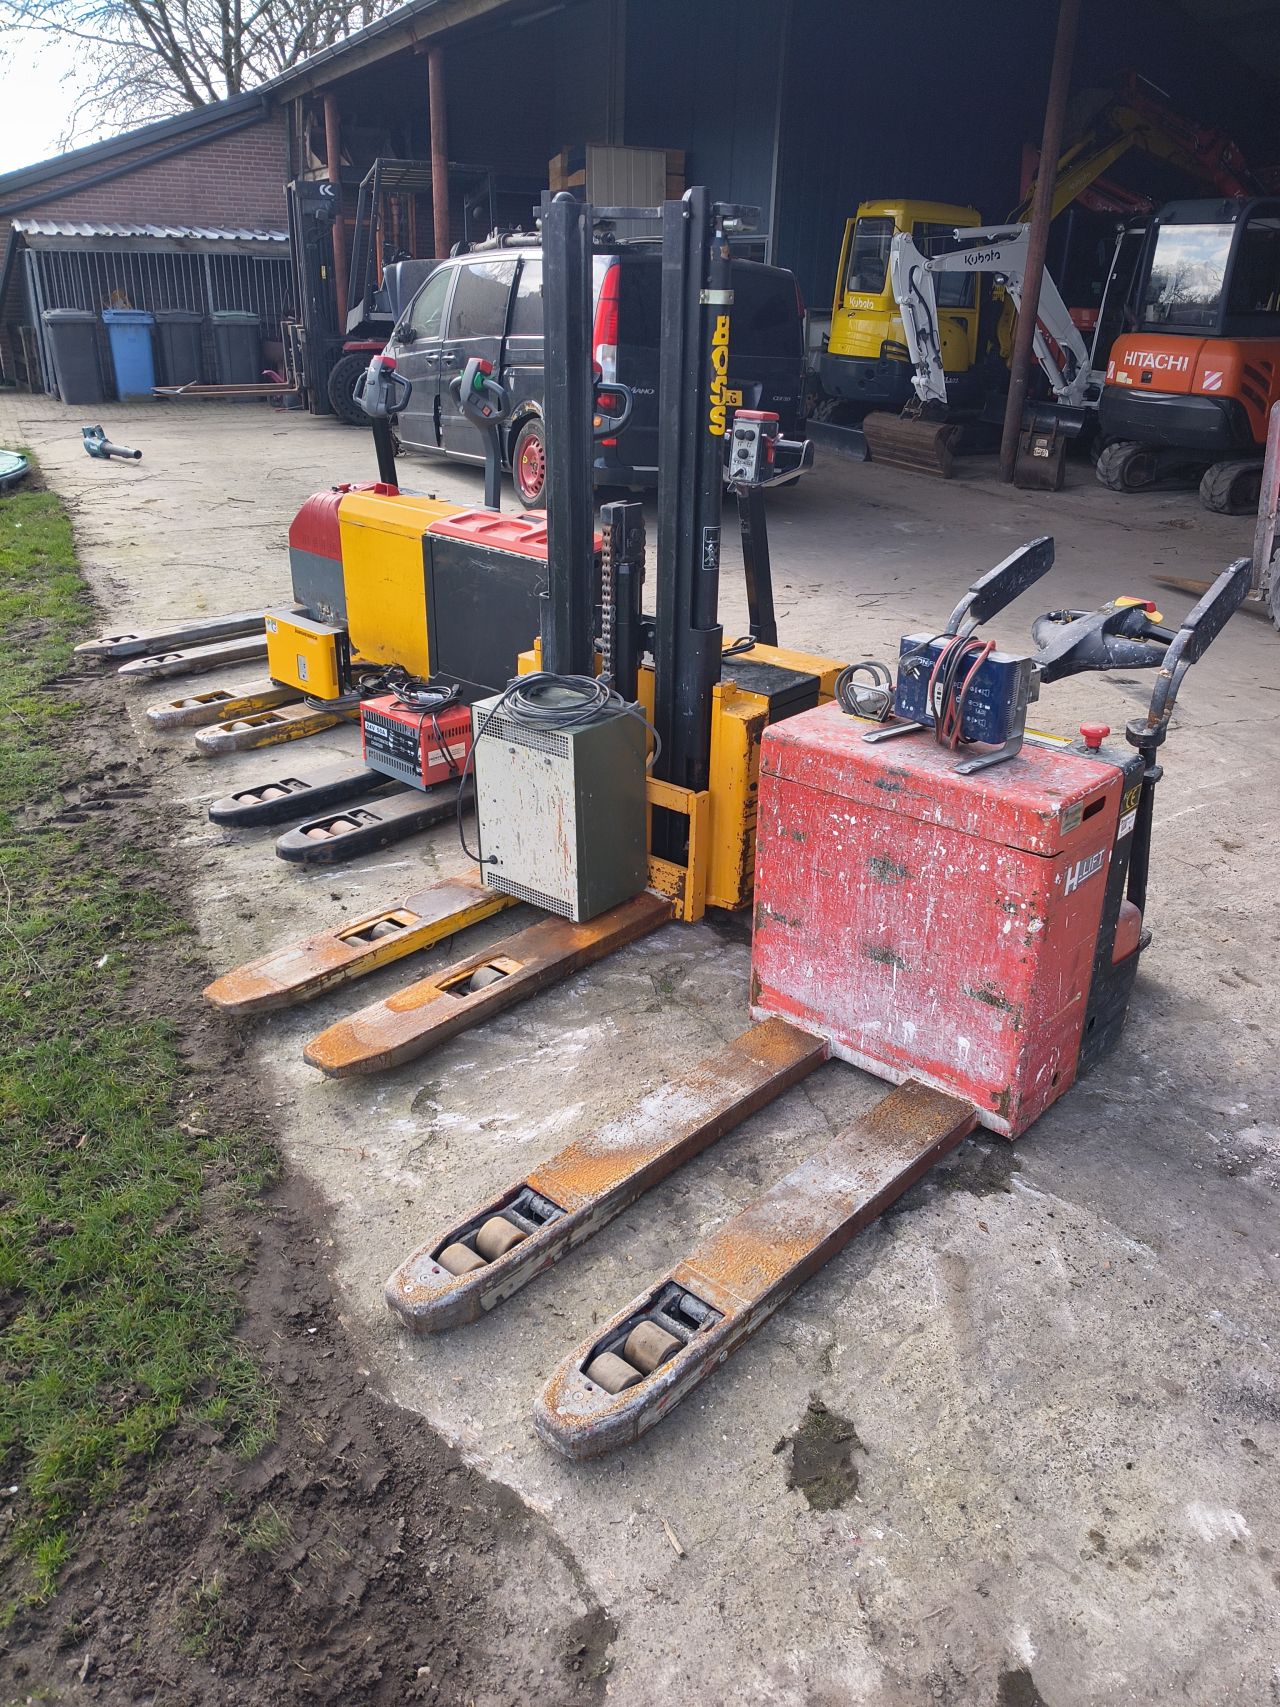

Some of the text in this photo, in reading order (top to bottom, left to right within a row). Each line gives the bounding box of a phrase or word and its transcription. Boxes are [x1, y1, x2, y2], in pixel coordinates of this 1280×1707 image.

[964, 250, 1001, 266] Kubota
[849, 296, 874, 309] Kubota
[1123, 350, 1190, 372] HITACHI
[709, 315, 730, 436] BOSS
